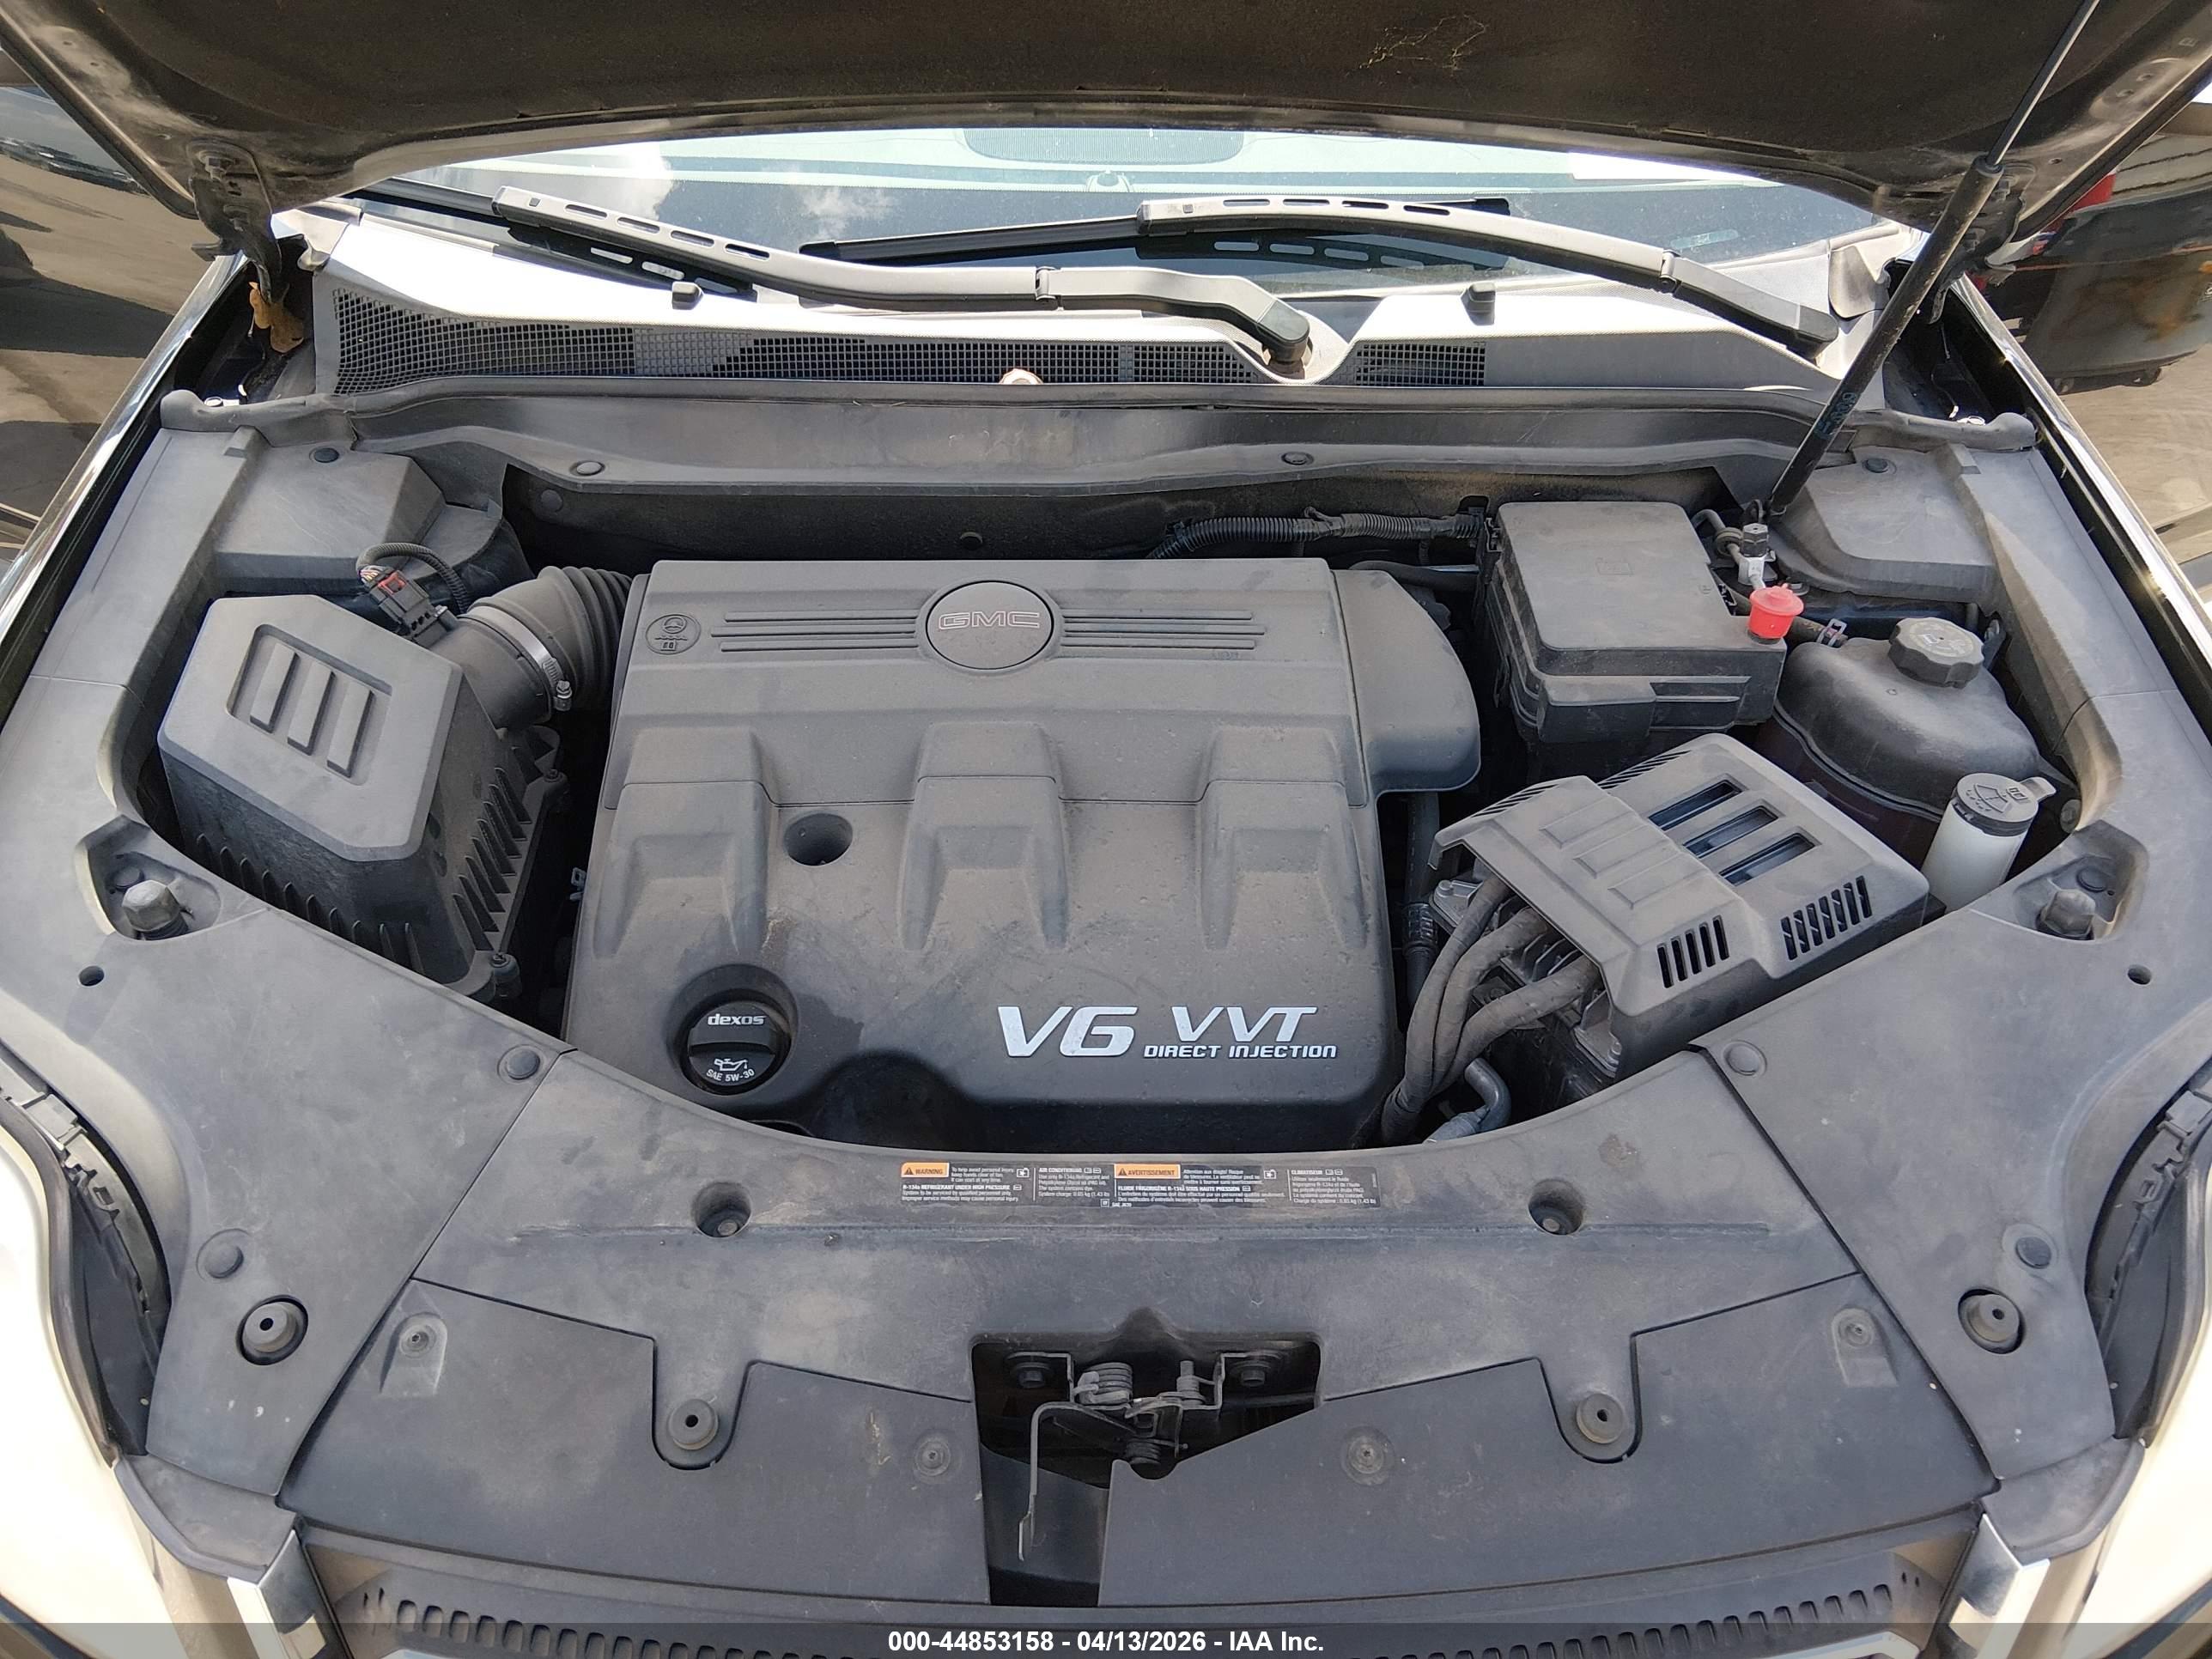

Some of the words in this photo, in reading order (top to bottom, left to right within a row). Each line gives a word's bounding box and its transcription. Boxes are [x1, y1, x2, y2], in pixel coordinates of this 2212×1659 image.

[939, 611, 1040, 629] GMC
[708, 1013, 767, 1025] dexos
[997, 1006, 1139, 1057] V6
[1171, 1006, 1318, 1042] VVT
[1144, 1045, 1221, 1058] DIRECT
[1229, 1045, 1336, 1058] INJECTION
[706, 1069, 723, 1082] SAE
[725, 1069, 755, 1082] 5W-30
